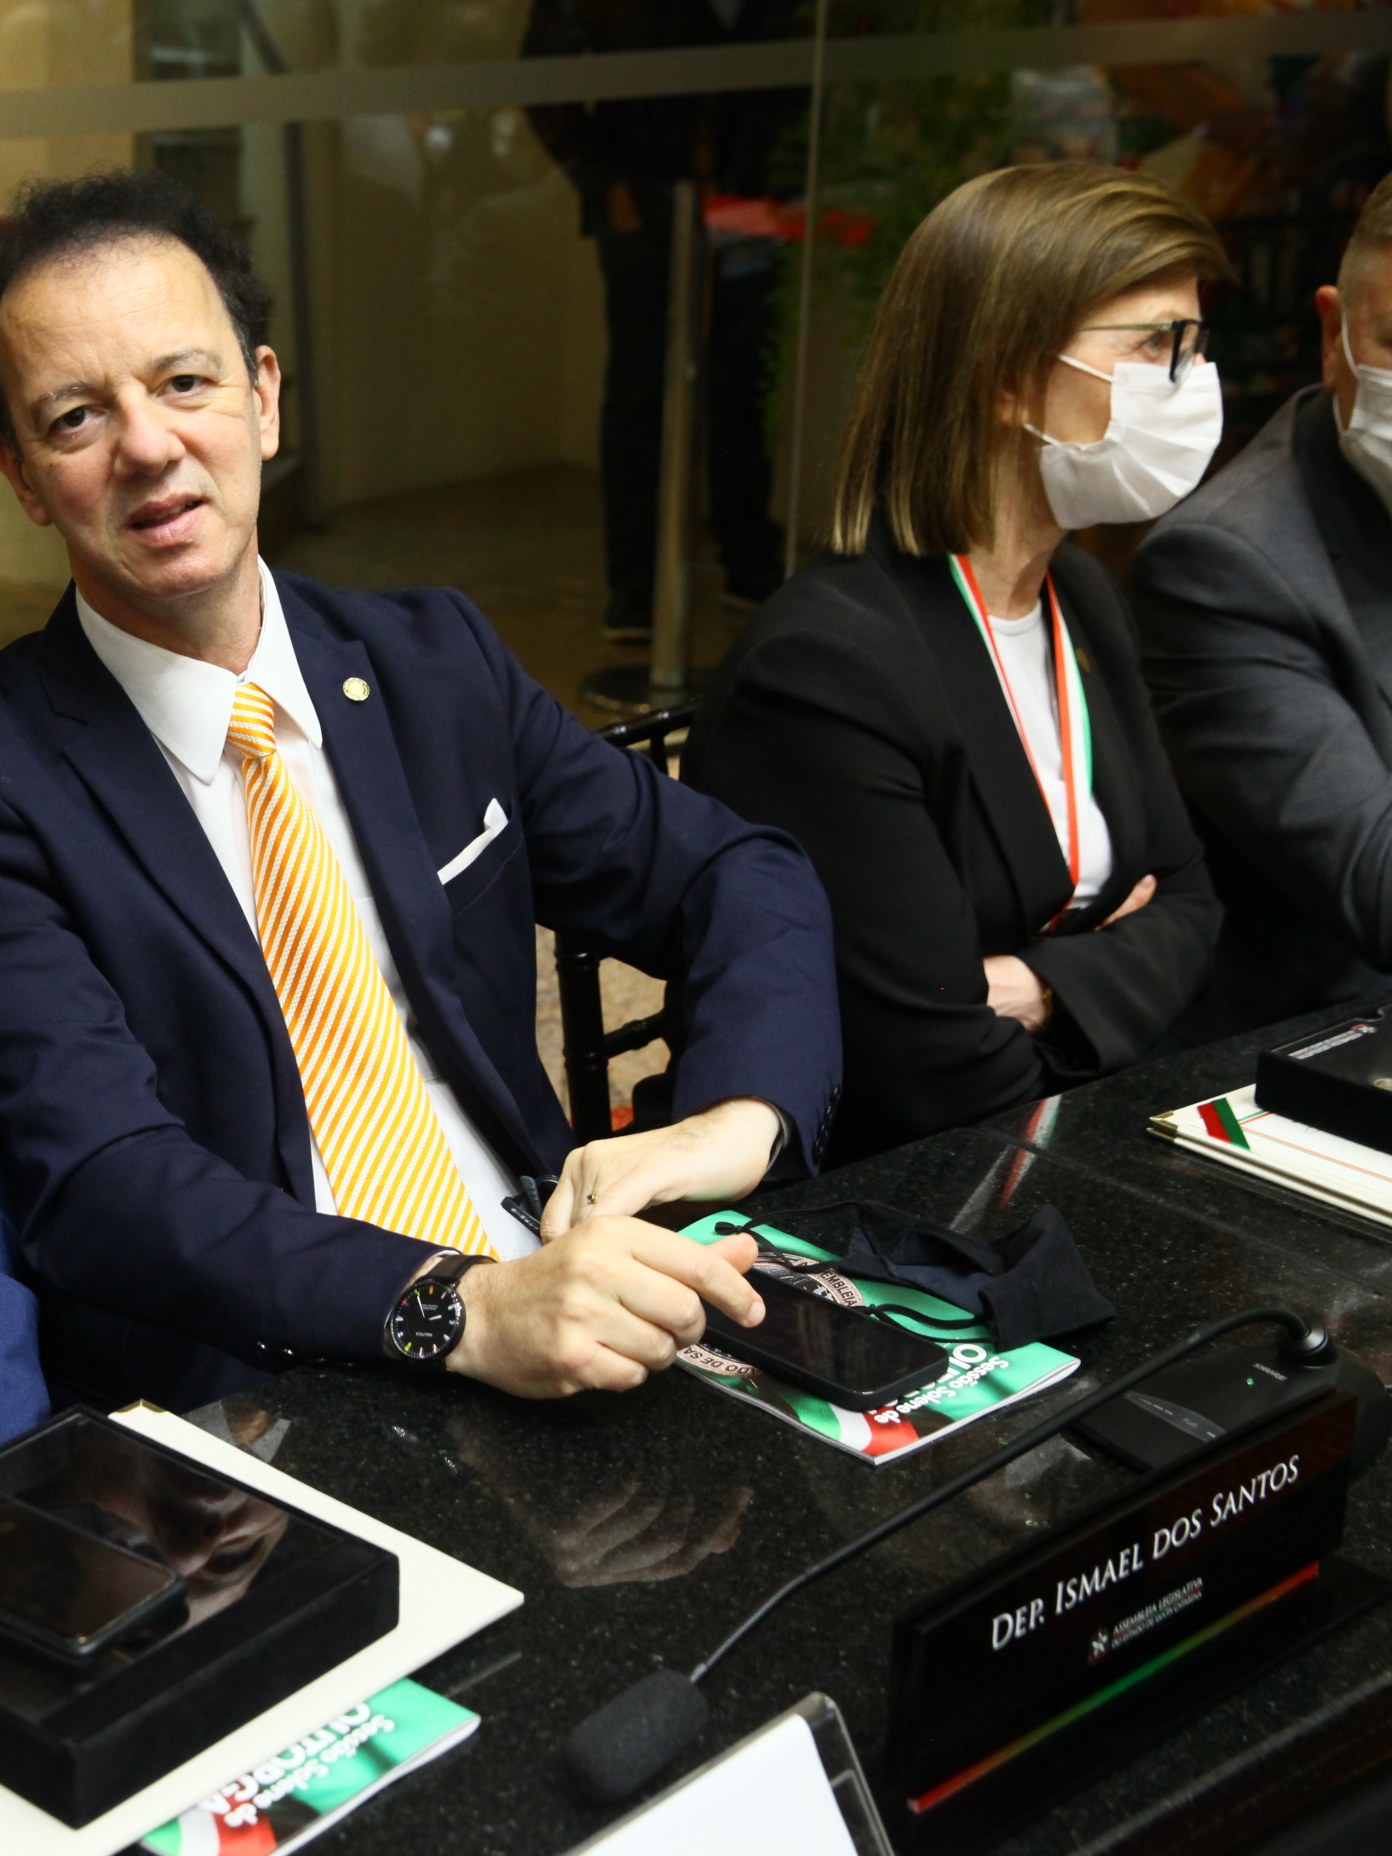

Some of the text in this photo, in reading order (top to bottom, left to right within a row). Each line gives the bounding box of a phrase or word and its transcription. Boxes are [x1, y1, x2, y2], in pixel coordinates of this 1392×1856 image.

[873, 1356, 1009, 1424] Sessão Solene de
[992, 1454, 1300, 1651] DEP. ISMAEL DOS SANTOS
[224, 1713, 396, 1828] Sessão Solene de
